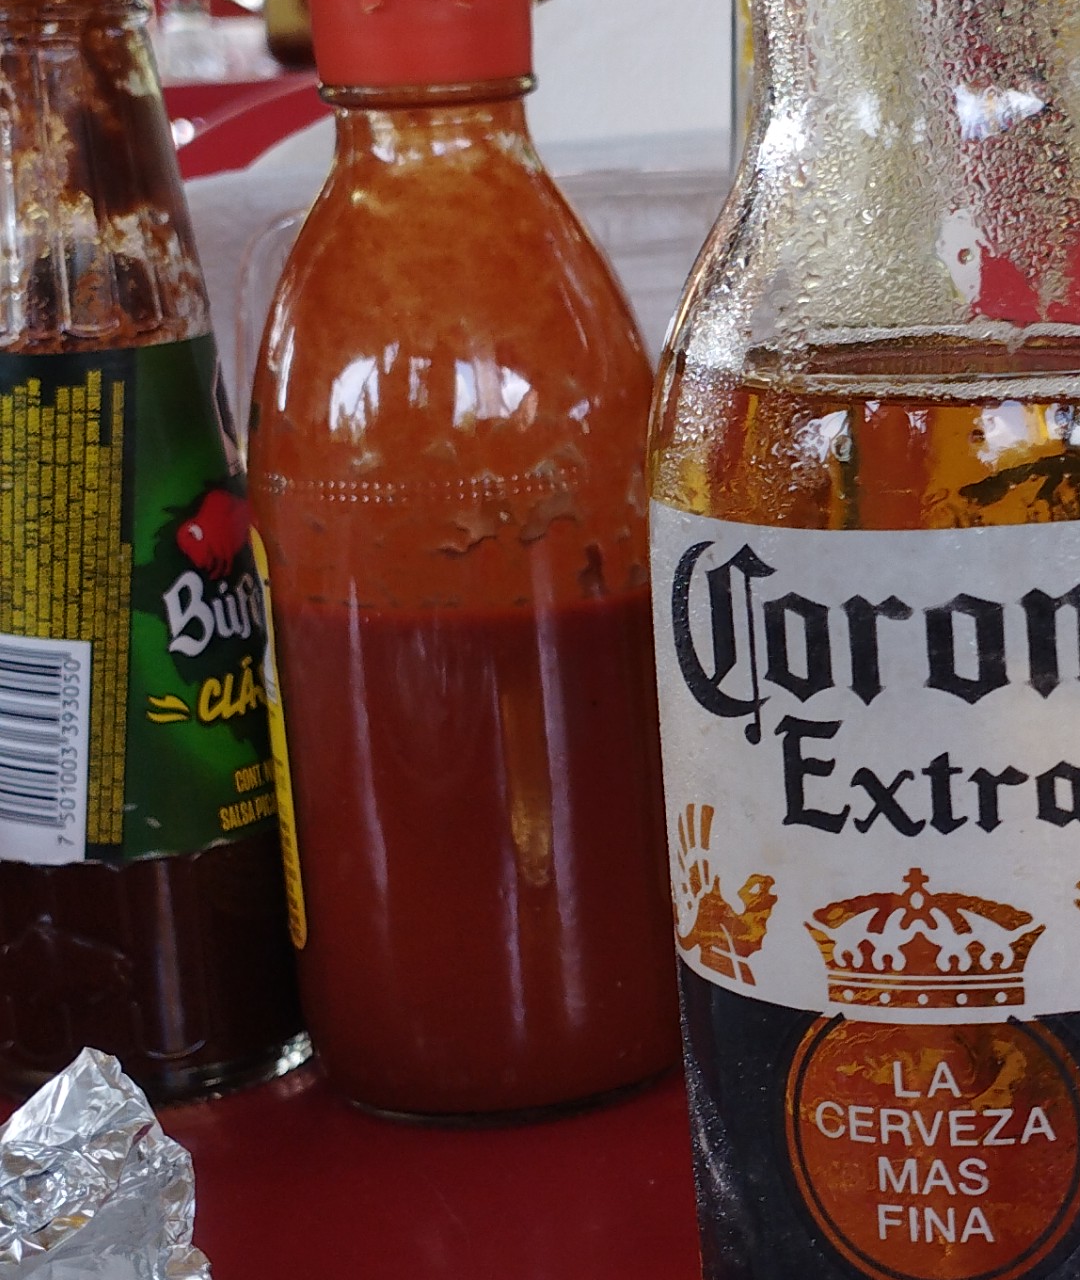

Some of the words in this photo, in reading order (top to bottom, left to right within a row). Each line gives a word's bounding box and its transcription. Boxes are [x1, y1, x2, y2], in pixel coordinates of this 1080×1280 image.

[892, 1060, 963, 1099] LA
[814, 1100, 1057, 1148] CERVEZA
[877, 1156, 990, 1196] MAS
[877, 1203, 996, 1244] FINA
